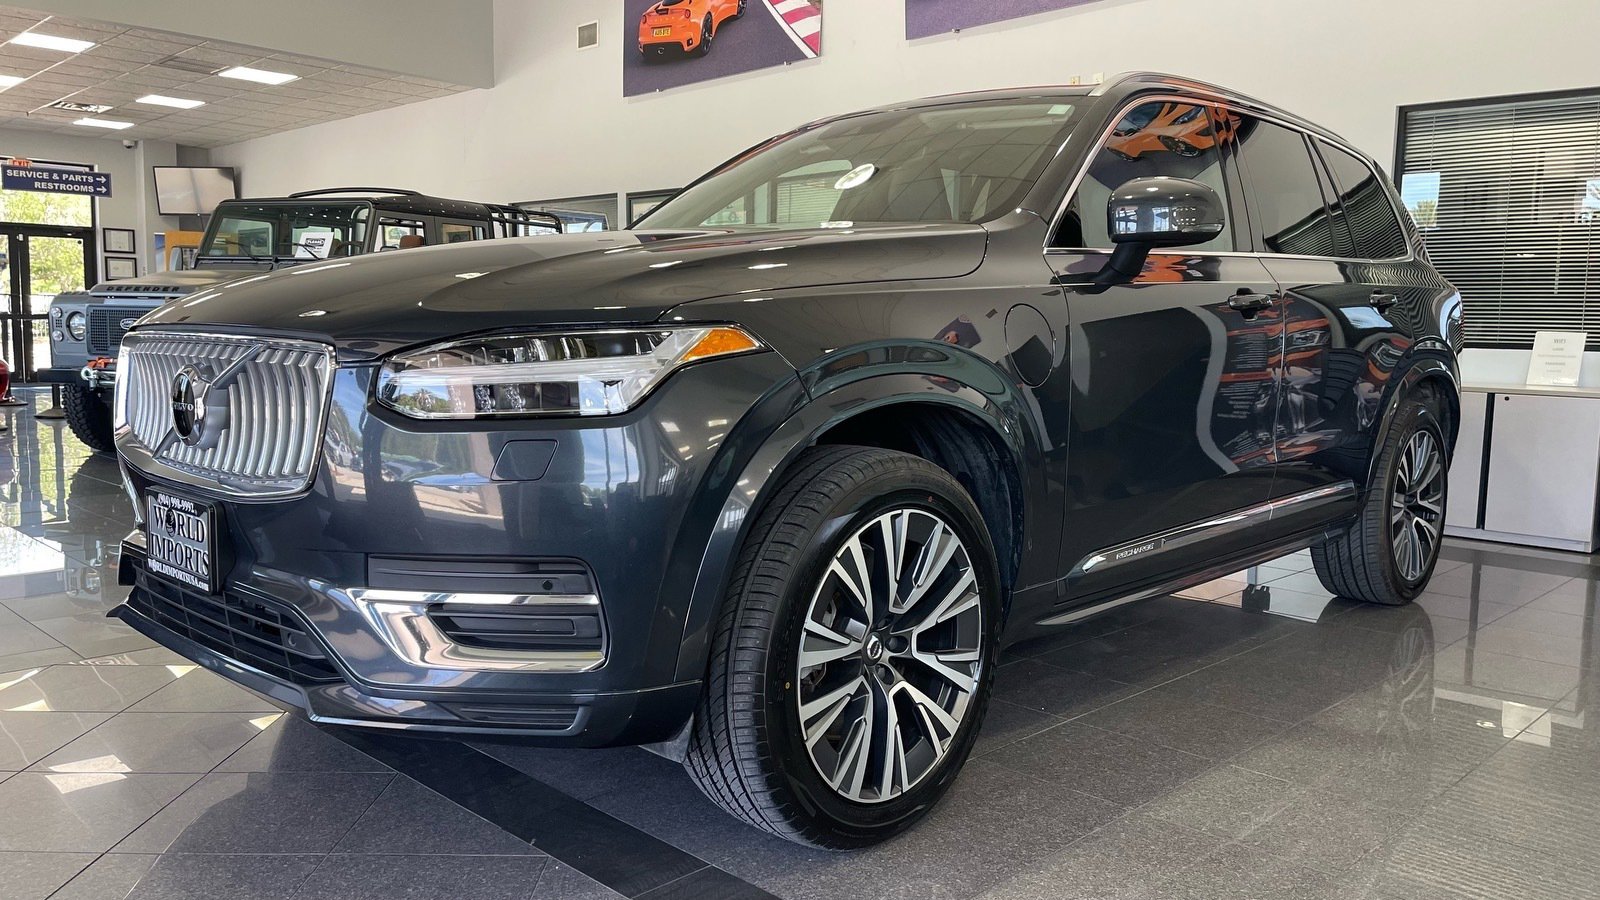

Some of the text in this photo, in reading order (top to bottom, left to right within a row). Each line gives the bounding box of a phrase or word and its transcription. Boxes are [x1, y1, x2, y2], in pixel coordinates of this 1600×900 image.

[6, 169, 94, 183] SERVICE & PARTS
[34, 181, 94, 192] RESTROOMS
[153, 504, 207, 543] WORLD
[150, 532, 209, 576] IMPORTS
